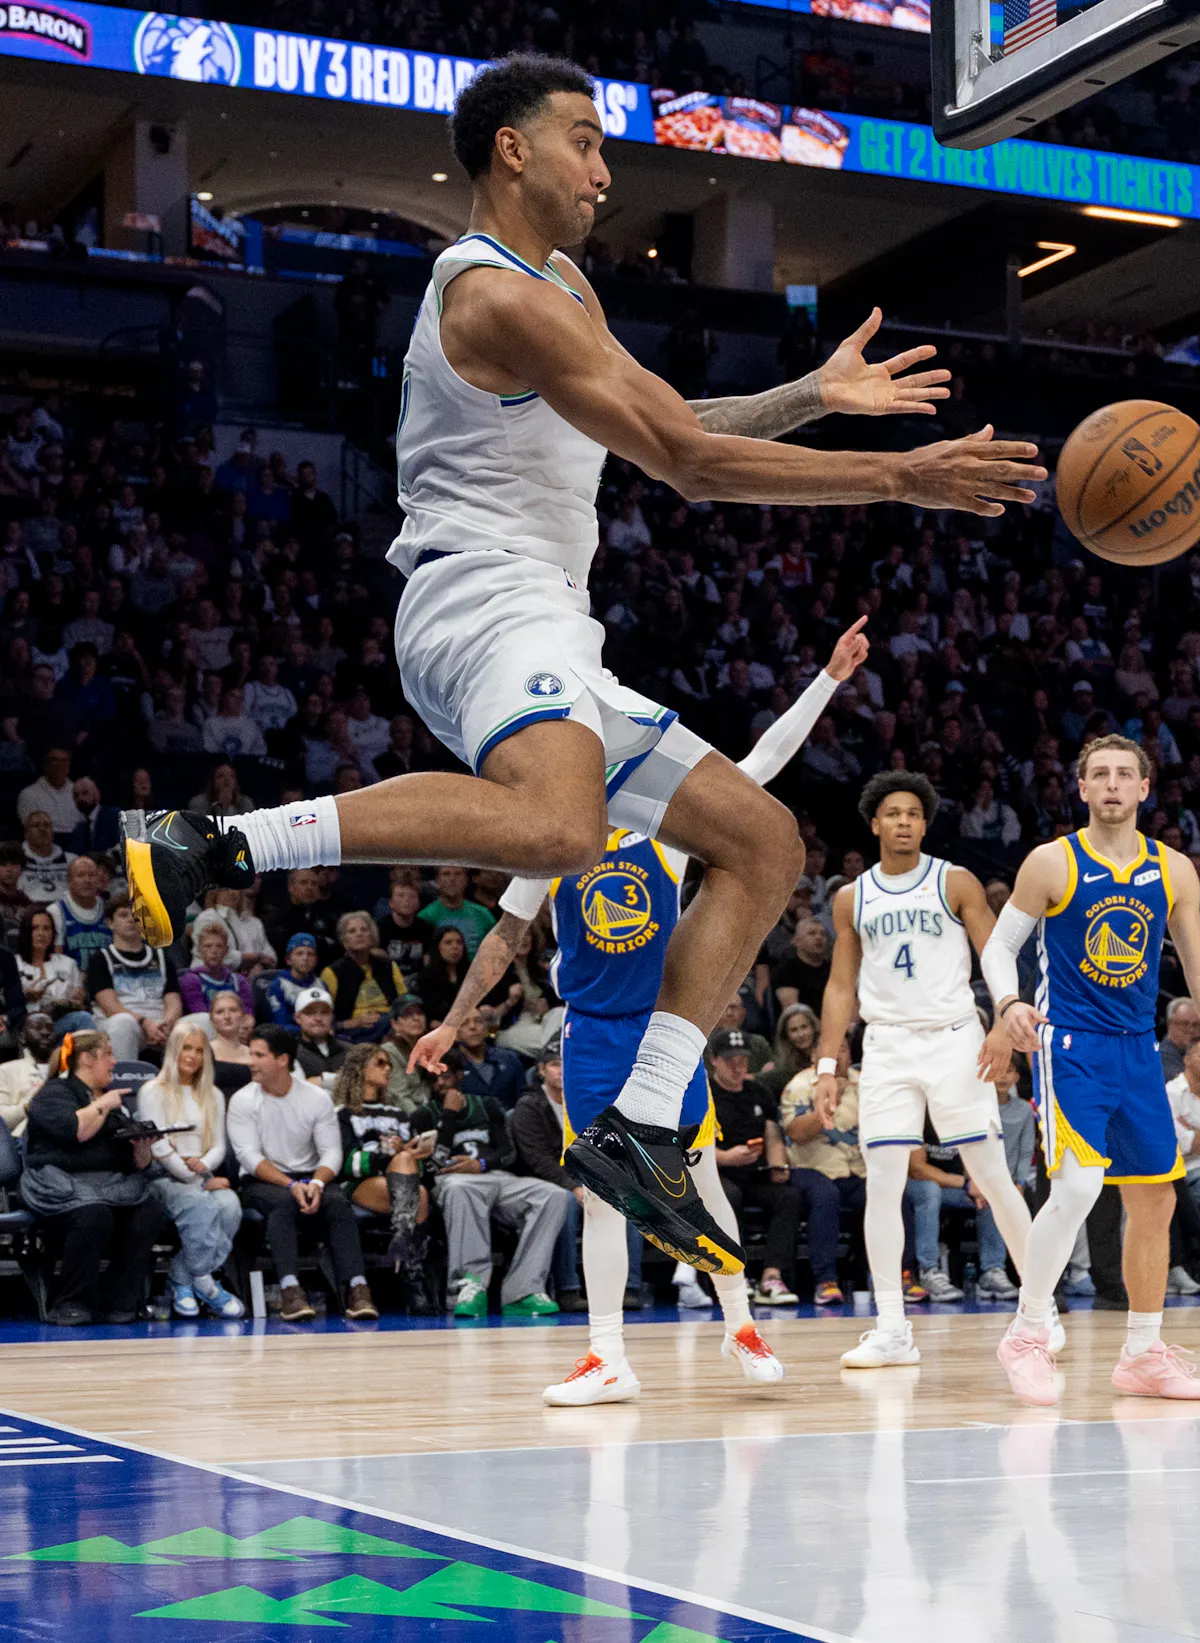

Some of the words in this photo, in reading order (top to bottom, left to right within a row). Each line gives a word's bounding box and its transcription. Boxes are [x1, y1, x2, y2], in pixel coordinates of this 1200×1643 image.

[253, 32, 321, 94] BUY
[325, 42, 347, 98] 3
[351, 46, 410, 106] RED
[860, 121, 904, 173] GET
[909, 128, 927, 177] 2
[992, 142, 1093, 199] WOLVES
[1096, 155, 1193, 213] TICKETS
[576, 861, 615, 891] GOLDEN
[618, 861, 649, 881] STATE
[623, 884, 639, 906] 3
[1085, 895, 1126, 919] GOLDEN
[1129, 897, 1155, 921] STATE
[585, 920, 660, 954] WARRIORS
[864, 909, 943, 949] WOLVES
[1128, 922, 1142, 942] 2
[893, 942, 916, 980] 4
[1079, 957, 1149, 988] WARRIORS
